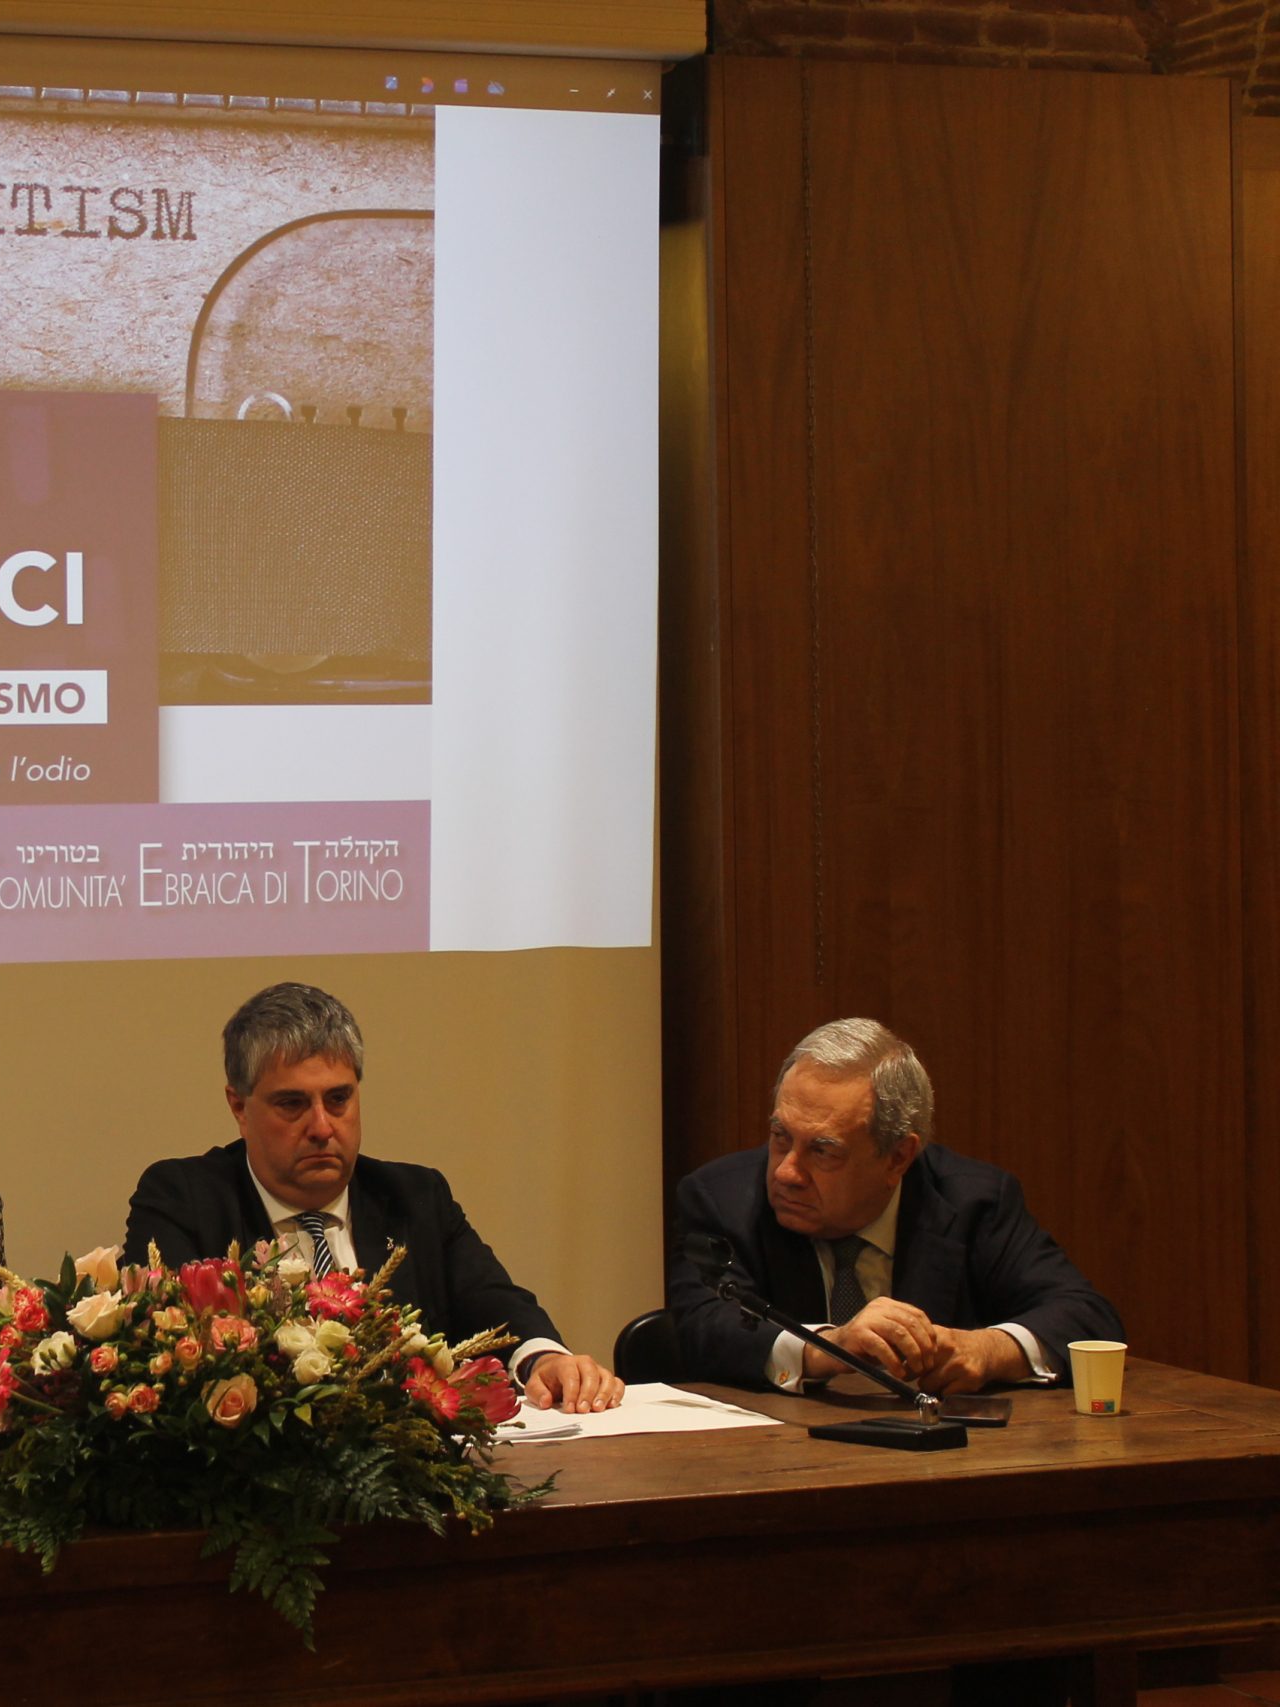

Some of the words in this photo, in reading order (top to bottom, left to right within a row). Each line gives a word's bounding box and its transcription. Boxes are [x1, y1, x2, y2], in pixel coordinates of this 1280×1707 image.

[10, 756, 91, 783] l’odio
[15, 844, 101, 864] בטורינו
[181, 841, 275, 861] היהודית
[324, 836, 400, 864] הקהלה
[139, 843, 255, 907] EBRAICA
[264, 871, 288, 905] DI
[293, 840, 404, 904] TORINO
